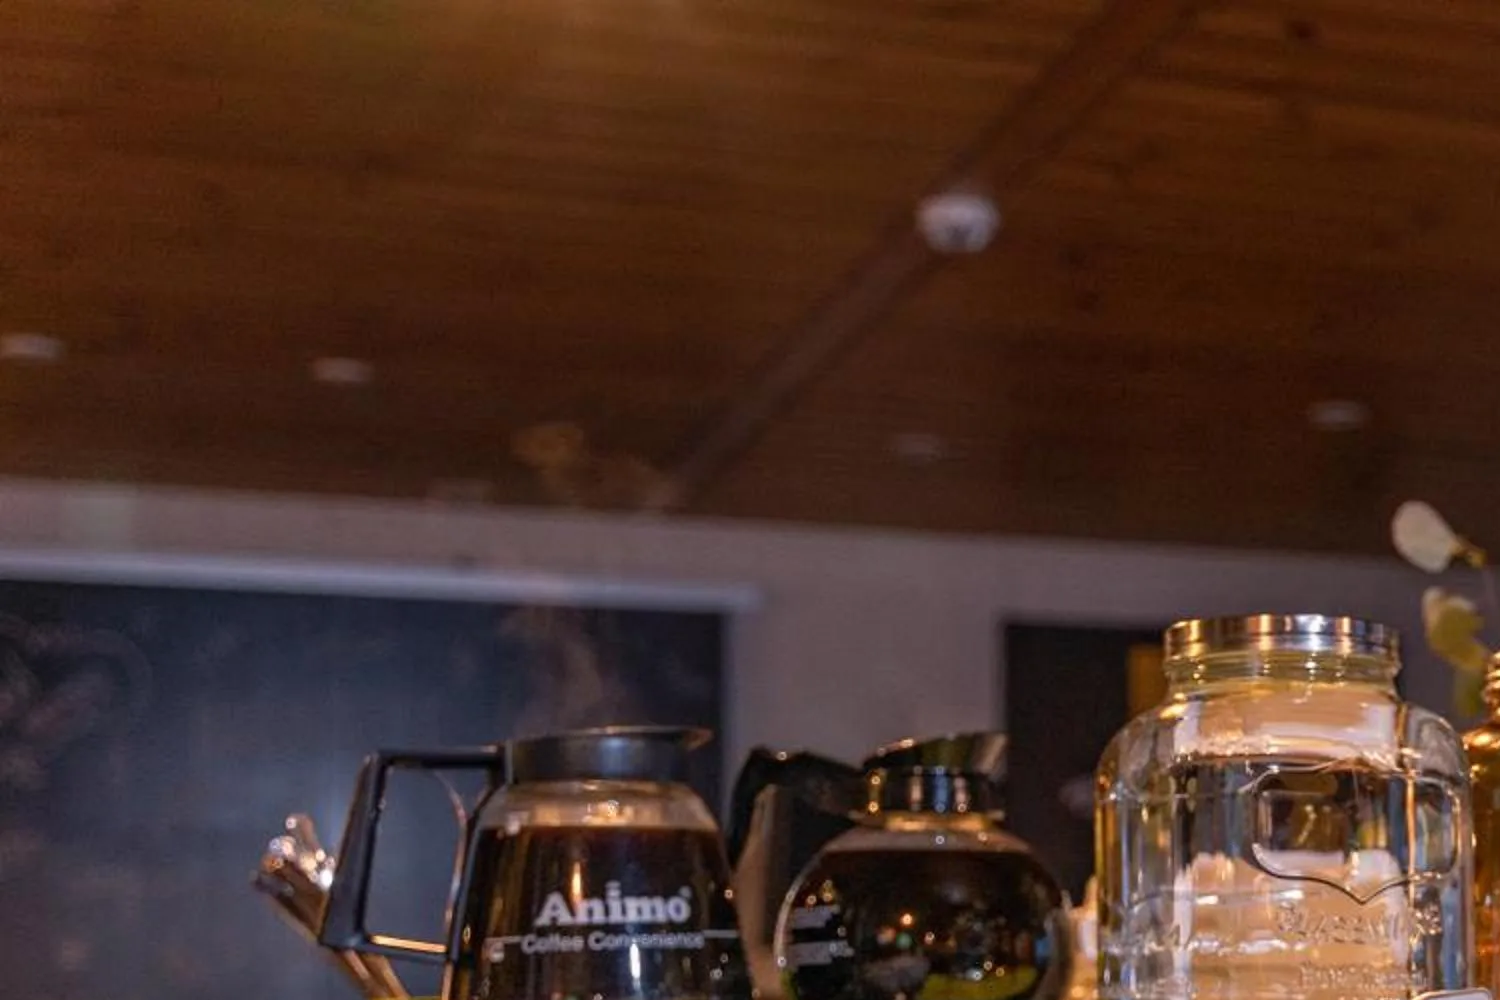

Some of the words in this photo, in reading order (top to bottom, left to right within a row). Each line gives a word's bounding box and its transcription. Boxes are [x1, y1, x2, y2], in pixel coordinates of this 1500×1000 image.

[534, 880, 691, 926] Animo
[521, 931, 585, 953] Coffee
[587, 929, 705, 950] Convenience
